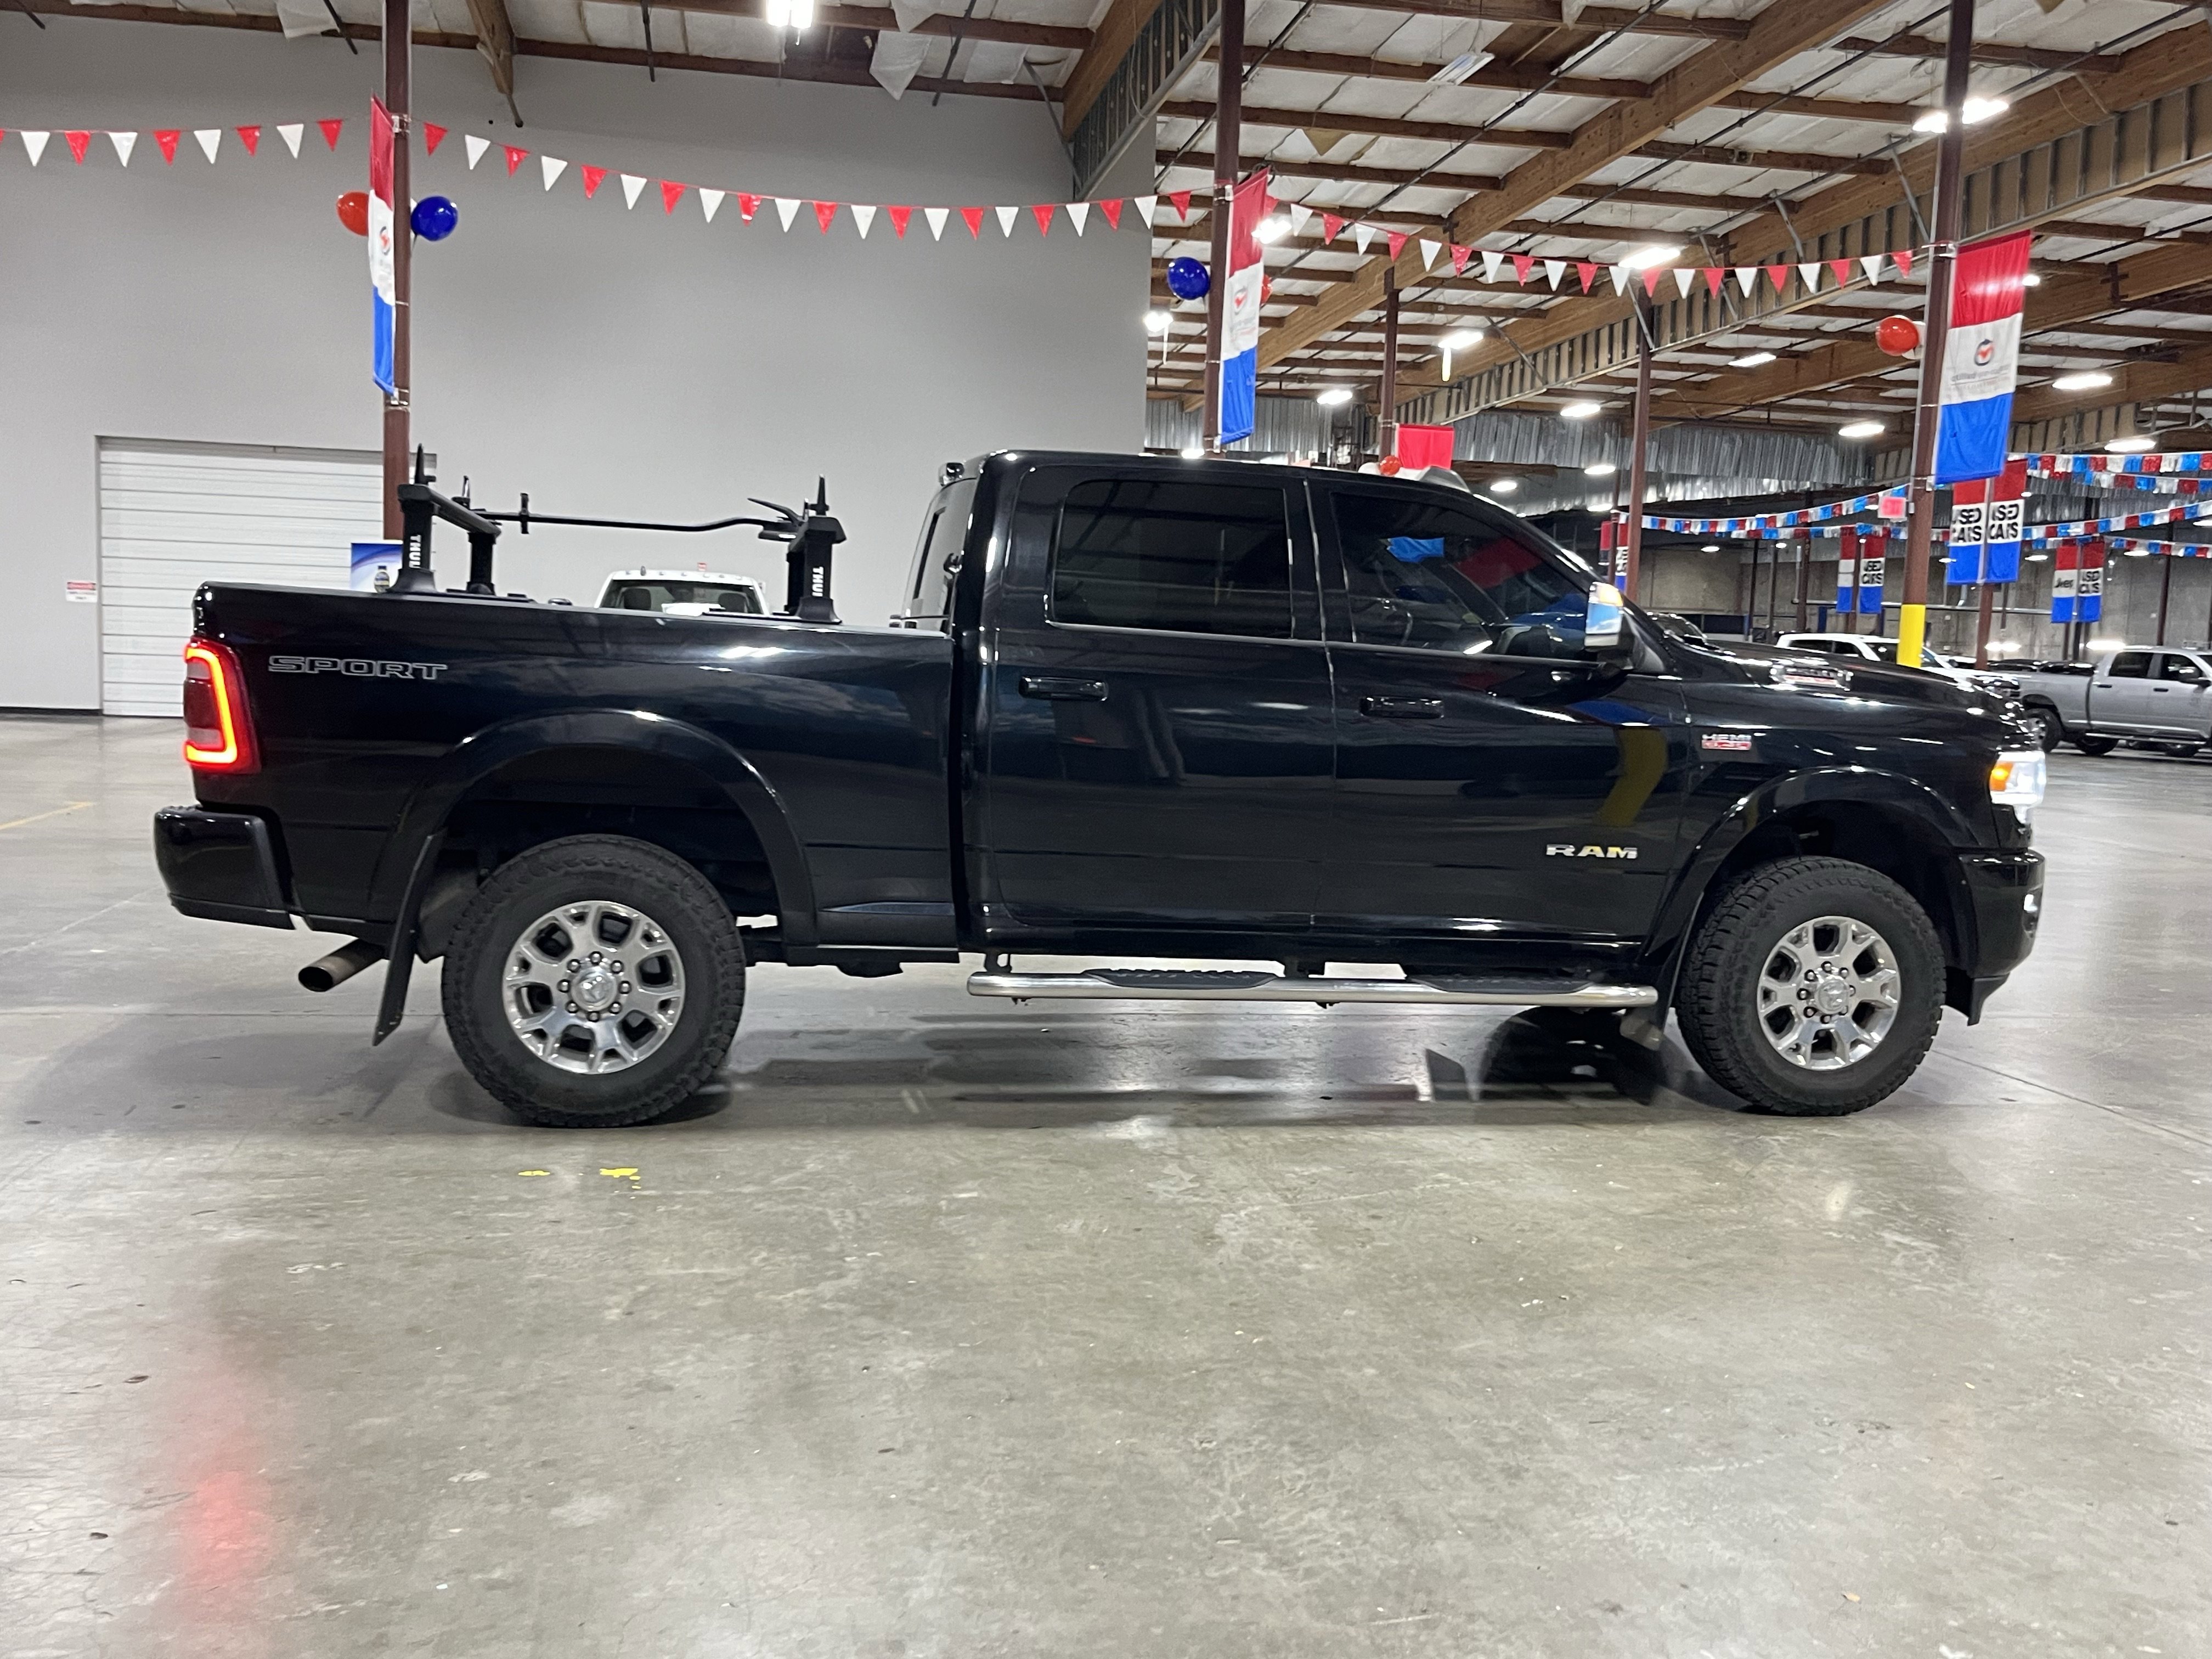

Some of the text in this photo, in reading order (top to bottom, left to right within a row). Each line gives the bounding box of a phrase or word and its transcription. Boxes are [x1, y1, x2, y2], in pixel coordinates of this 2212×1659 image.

[409, 534, 422, 569] THUL
[268, 656, 448, 680] SPORT
[1546, 844, 1638, 859] RAM
